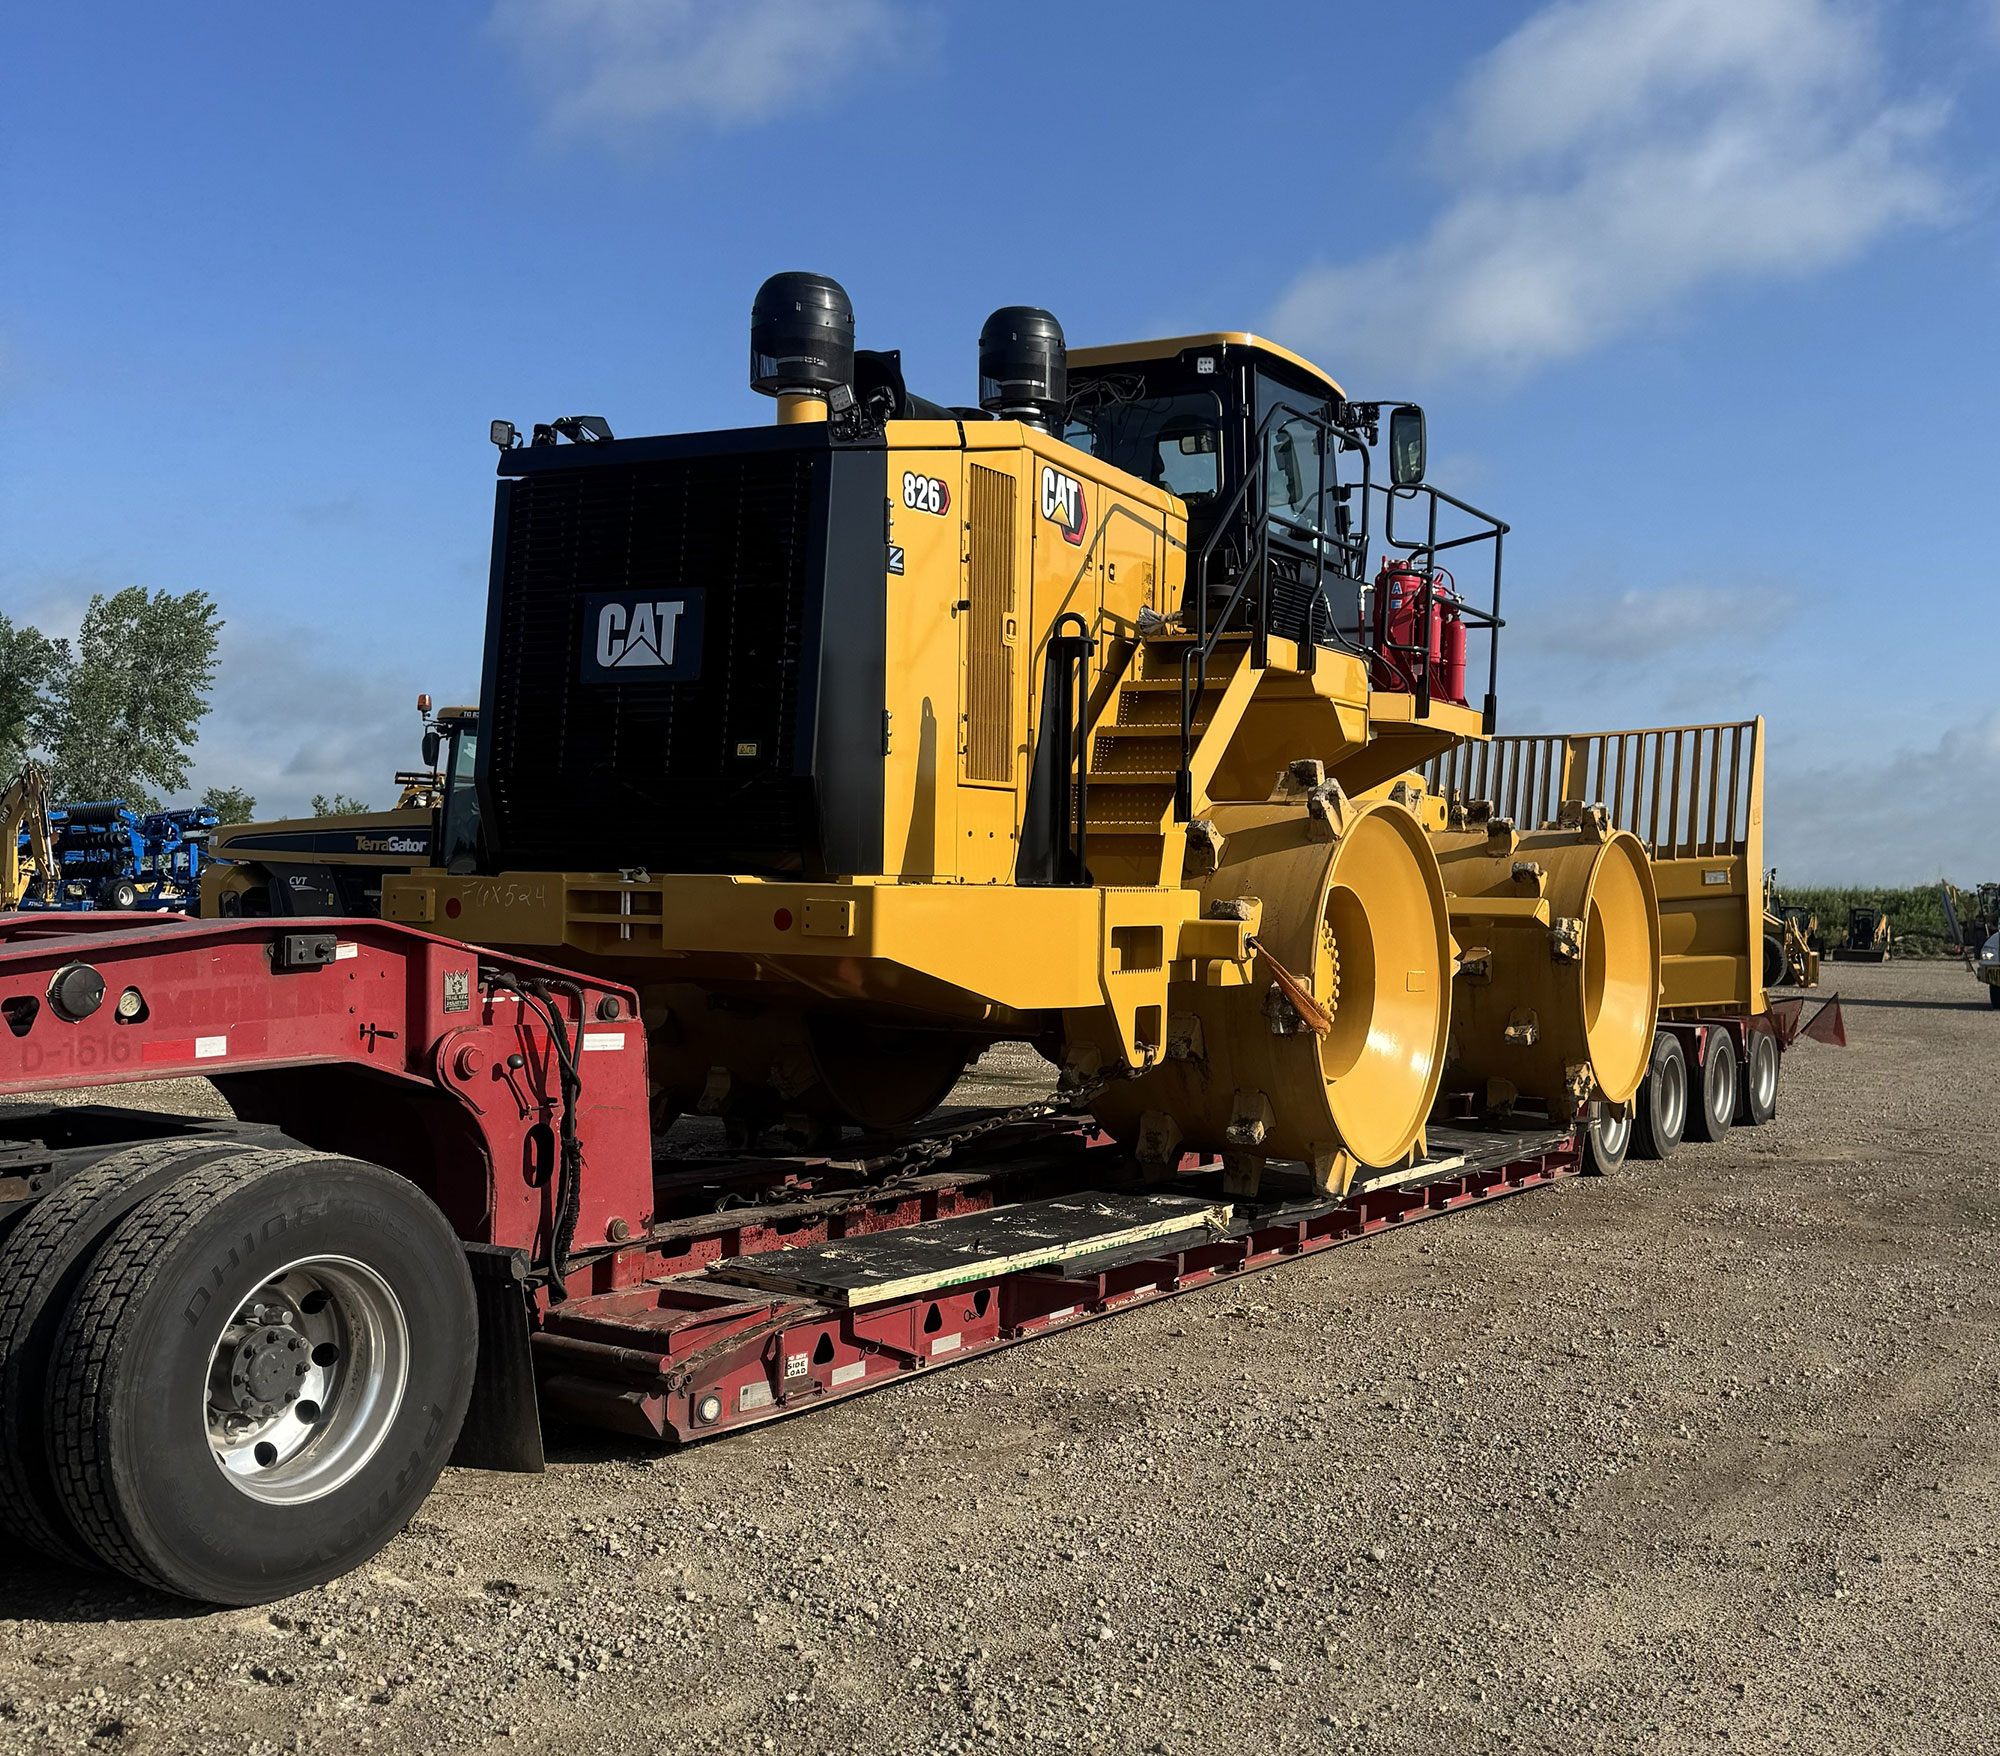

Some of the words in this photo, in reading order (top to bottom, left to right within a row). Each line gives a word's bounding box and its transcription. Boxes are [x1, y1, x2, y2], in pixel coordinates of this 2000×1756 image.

[903, 470, 940, 514] 826
[1041, 466, 1079, 529] CAT
[596, 600, 685, 668] CAT
[355, 835, 427, 853] TerraGator
[289, 876, 308, 885] CVT
[787, 1360, 805, 1370] SIDE
